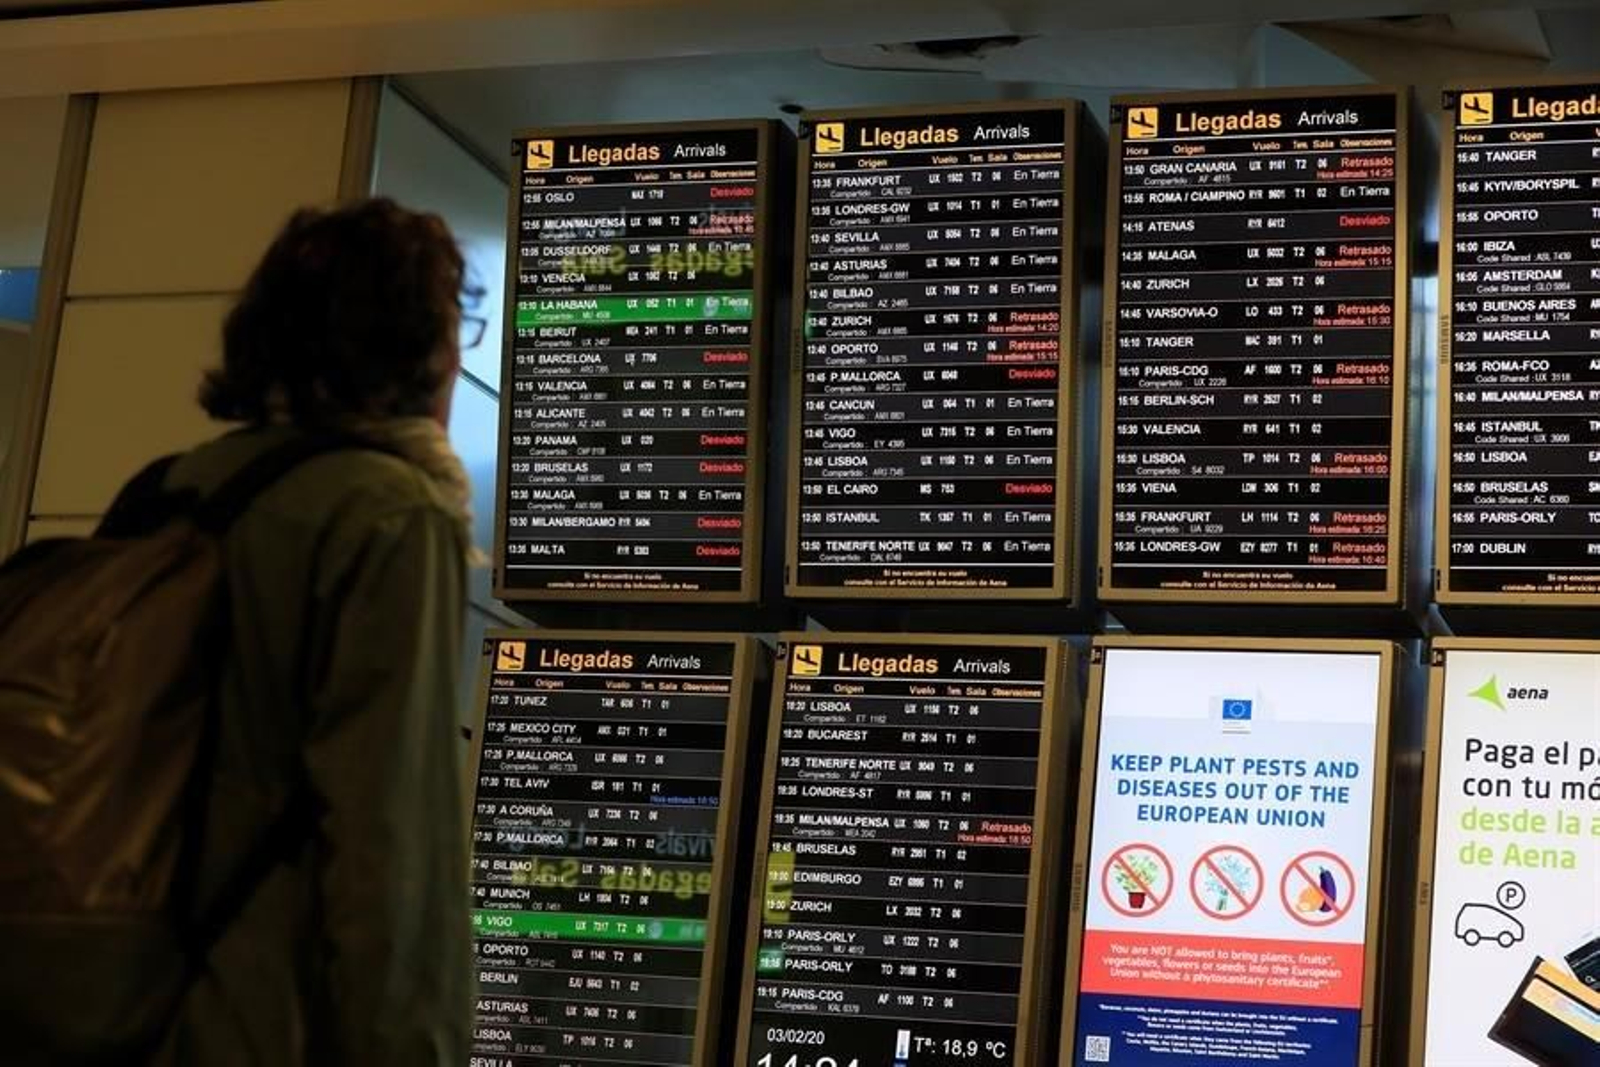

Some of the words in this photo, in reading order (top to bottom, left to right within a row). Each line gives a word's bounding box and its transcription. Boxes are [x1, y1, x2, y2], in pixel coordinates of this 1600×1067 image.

[1176, 110, 1281, 135] Llegadas
[1298, 110, 1359, 126] Arrivals
[861, 125, 959, 149] Llegadas
[974, 125, 1030, 140] Arrivals
[1173, 144, 1205, 155] Origen
[1253, 141, 1280, 151] Vuelo
[569, 143, 660, 166] Llegadas
[674, 144, 726, 158] Arrivals
[1485, 151, 1536, 162] TANGER
[1150, 164, 1183, 175] GRAN
[1186, 161, 1237, 173] CANARIA
[1341, 157, 1393, 168] Retrasado
[836, 175, 901, 187] FRANKFURT
[1484, 180, 1579, 191] KYIV/BORYSPIL
[545, 192, 574, 202] OSLO
[710, 187, 754, 197] Desviado
[1149, 192, 1181, 203] ROMA
[1191, 190, 1245, 201] CIAMPINO
[1340, 187, 1356, 197] En
[1359, 186, 1390, 196] Tierra
[835, 203, 910, 215] LONDRES-GW
[1484, 210, 1538, 221] OPORTO
[1148, 221, 1194, 232] ATENAS
[1340, 215, 1390, 226] Desviado
[835, 232, 880, 243] SEVILLA
[1484, 241, 1515, 251] IBIZA
[1148, 250, 1196, 261] MALAGA
[833, 259, 887, 270] ASTURIAS
[1484, 270, 1562, 281] AMSTERDAM
[1146, 279, 1190, 289] ZURICH
[833, 288, 873, 299] BILBAO
[541, 301, 554, 310] LA
[556, 300, 598, 310] HABANA
[1483, 300, 1535, 311] BUENOS
[1538, 299, 1576, 309] AIRES
[1146, 307, 1218, 319] VARSOVIA-O
[1338, 304, 1390, 315] Retrasado
[832, 316, 872, 326] ZURICH
[1011, 312, 1058, 322] Retrasado
[1483, 331, 1550, 341] MARSELLA
[1146, 337, 1193, 347] TANGER
[831, 344, 878, 354] OPORTO
[539, 353, 601, 364] BARCELONA
[1145, 365, 1208, 377] PARIS-CDG
[1482, 361, 1549, 371] ROMA-FCO
[830, 371, 900, 382] P.MALLORCA
[538, 381, 587, 391] VALENCIA
[703, 380, 717, 389] En
[719, 380, 746, 389] Tierra
[1144, 395, 1214, 406] BERLIN-SCH
[1482, 391, 1584, 402] MILAN/MALPENSA
[829, 400, 875, 410] CANCUN
[536, 408, 586, 418] ALICANTE
[1143, 424, 1200, 435] VALENCIA
[1481, 422, 1542, 432] ISTANBUL
[829, 428, 855, 439] VIGO
[535, 435, 577, 445] PANAMA
[828, 456, 868, 466] LISBOA
[1143, 454, 1185, 464] LISBOA
[1481, 452, 1527, 462] LISBOA
[534, 463, 588, 473] BRUSELAS
[827, 485, 841, 495] EL
[844, 484, 878, 495] CAIRO
[1005, 483, 1052, 494] Desviado
[1142, 483, 1176, 493] VIENA
[1481, 482, 1548, 492] BRUSELAS
[533, 490, 575, 500] MALAGA
[826, 513, 880, 523] ISTANBUL
[1141, 512, 1211, 522] FRANKFURT
[1480, 513, 1556, 523] PARIS-ORLY
[531, 545, 565, 555] MALTA
[696, 545, 740, 556] Desviado
[826, 541, 875, 551] TENERIFE
[879, 541, 915, 552] NORTE
[1141, 542, 1221, 553] LONDRES-GW
[1452, 544, 1474, 553] 17:00
[1480, 544, 1526, 553] DUBLIN
[540, 650, 633, 672] Llegadas
[647, 655, 701, 669] Arrivals
[838, 653, 938, 676] Llegadas
[953, 658, 1010, 674] Arrivals
[1507, 687, 1549, 700] aena
[514, 696, 547, 706] TUNEZ
[810, 701, 851, 712] LISBOA
[510, 723, 550, 733] MEXICO
[552, 724, 576, 734] CITY
[808, 729, 868, 740] BUCAREST
[506, 751, 573, 761] P.MALLORCA
[1465, 738, 1534, 768] Paga
[1544, 741, 1569, 765] el
[806, 758, 856, 769] TENERIFE
[858, 760, 896, 770] NORTE
[1111, 754, 1162, 771] KEEP
[1170, 757, 1235, 774] PLANT
[1243, 760, 1306, 776] PESTS
[1315, 762, 1359, 779] AND
[504, 778, 522, 787] TEL
[525, 779, 549, 788] AVIV
[1463, 777, 1512, 797] con
[1522, 775, 1550, 799] tu
[802, 786, 874, 798] LONDRES-ST
[1118, 780, 1216, 798] DISEASES
[1225, 783, 1267, 800] OUT
[1275, 785, 1301, 801] OF
[1310, 787, 1349, 803] THE
[510, 805, 553, 816] CORUÑA
[1137, 805, 1248, 824] EUROPEAN
[1257, 809, 1325, 827] UNION
[800, 814, 889, 828] MILAN/MALPENSA
[982, 822, 1032, 833] Retrasado
[1461, 807, 1547, 834] desde
[1557, 811, 1581, 835] la
[797, 844, 856, 855] BRUSELAS
[1459, 841, 1493, 865] de
[1502, 842, 1576, 869] Aena
[494, 860, 531, 871] BILBAO
[794, 873, 862, 884] EDIMBURGO
[491, 889, 530, 899] MUNICH
[1506, 888, 1517, 902] P
[790, 901, 832, 912] ZURICH
[488, 917, 512, 927] VIGO
[788, 930, 856, 943] PARIS-ORLY
[483, 944, 528, 955] OPORTO
[1110, 944, 1129, 955] You
[1131, 946, 1148, 955] are
[1151, 945, 1173, 956] NOT
[1175, 947, 1215, 959] allowed
[1217, 951, 1229, 960] to
[1231, 949, 1258, 963] bring
[785, 960, 853, 972] PARIS-ORLY
[1162, 957, 1200, 970] flowers
[1249, 962, 1269, 974] into
[1271, 964, 1289, 975] the
[1292, 966, 1342, 979] European
[480, 972, 517, 983] BERLIN
[1110, 966, 1140, 977] Union
[1192, 971, 1264, 987] phytosanitary
[782, 988, 843, 1000] PARIS-CDG
[476, 1002, 528, 1013] ASTURIAS
[767, 1029, 824, 1044] 03/02/20
[943, 1039, 978, 1058] 18,9
